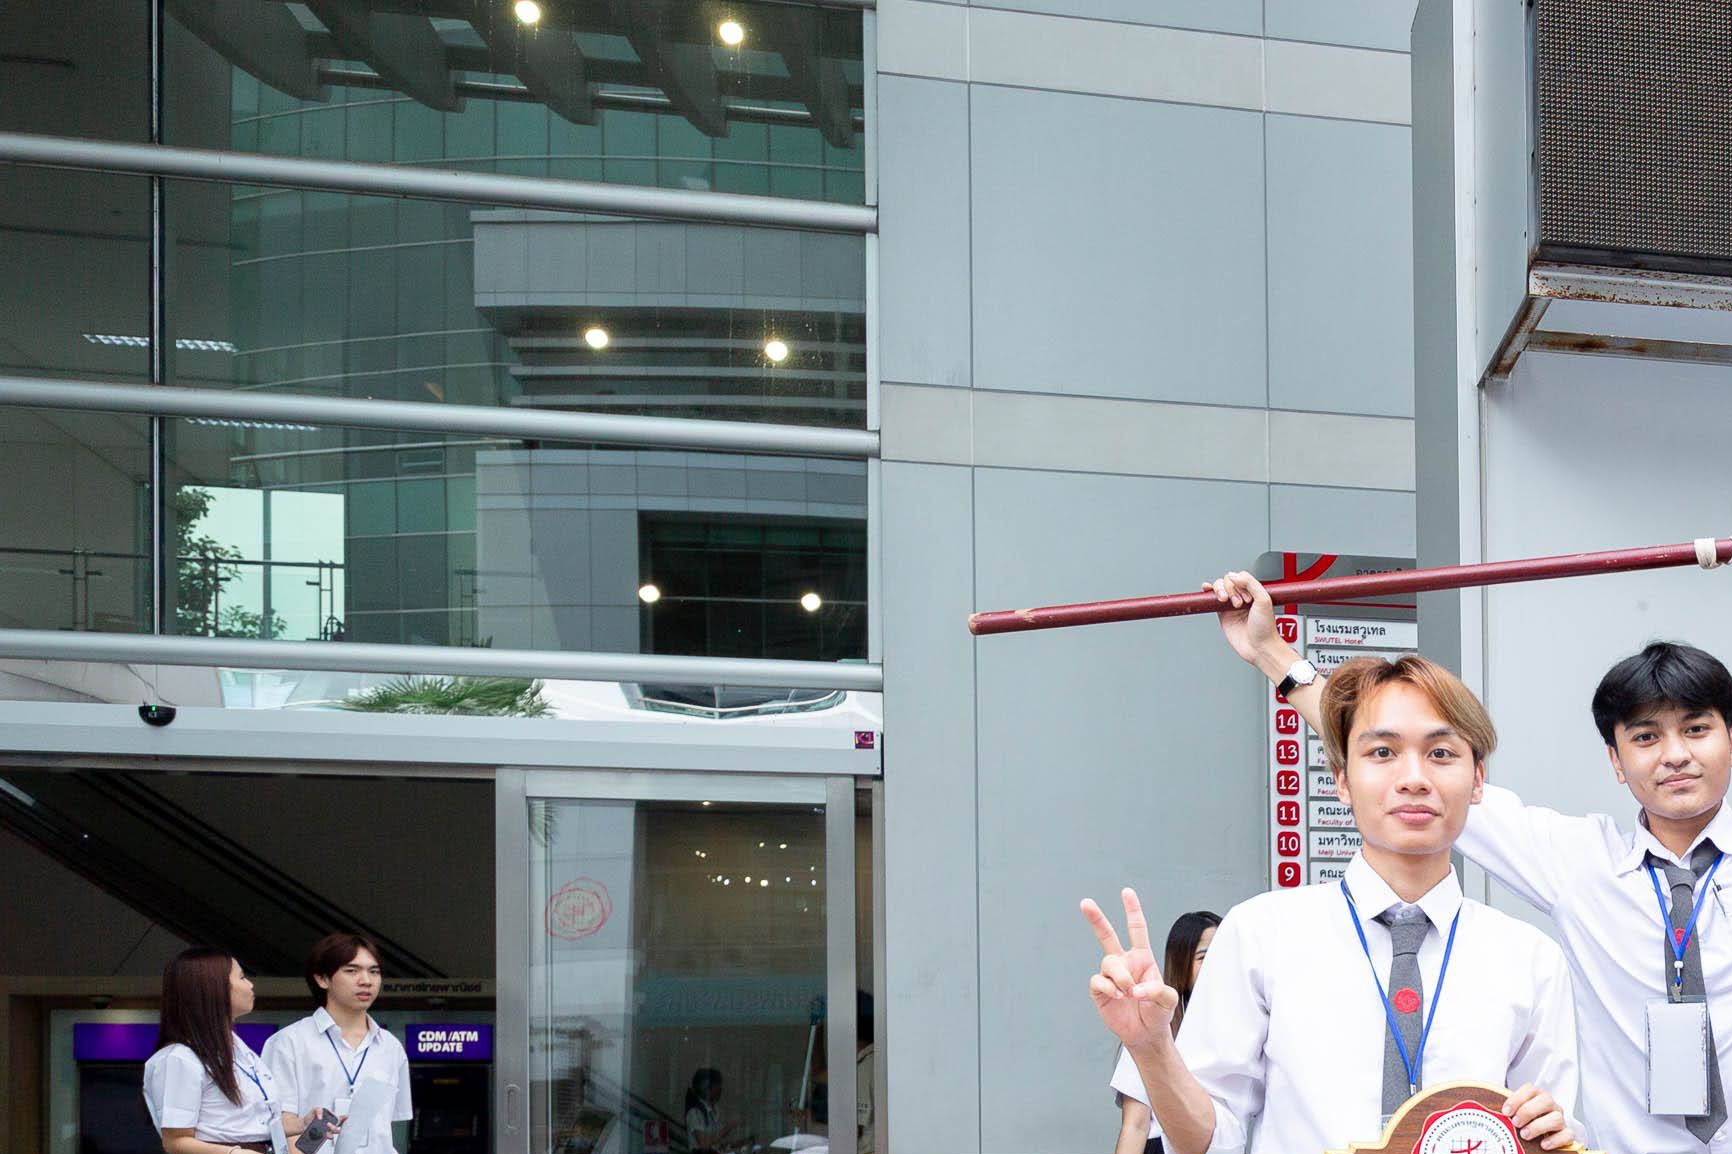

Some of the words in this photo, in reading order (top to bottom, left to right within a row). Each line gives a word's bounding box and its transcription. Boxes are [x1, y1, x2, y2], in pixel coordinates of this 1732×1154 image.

[1277, 622, 1296, 638] 17
[1315, 619, 1386, 639] โรงแรมสวูเทล
[1278, 713, 1297, 729] 14
[1279, 744, 1298, 760] 13
[1279, 775, 1298, 791] 12
[1279, 805, 1298, 821] 11
[1318, 818, 1343, 826] Faculty
[1345, 818, 1353, 826] of
[1280, 836, 1298, 851] 10
[1284, 867, 1295, 882] 9
[418, 1042, 463, 1052] UPDATE
